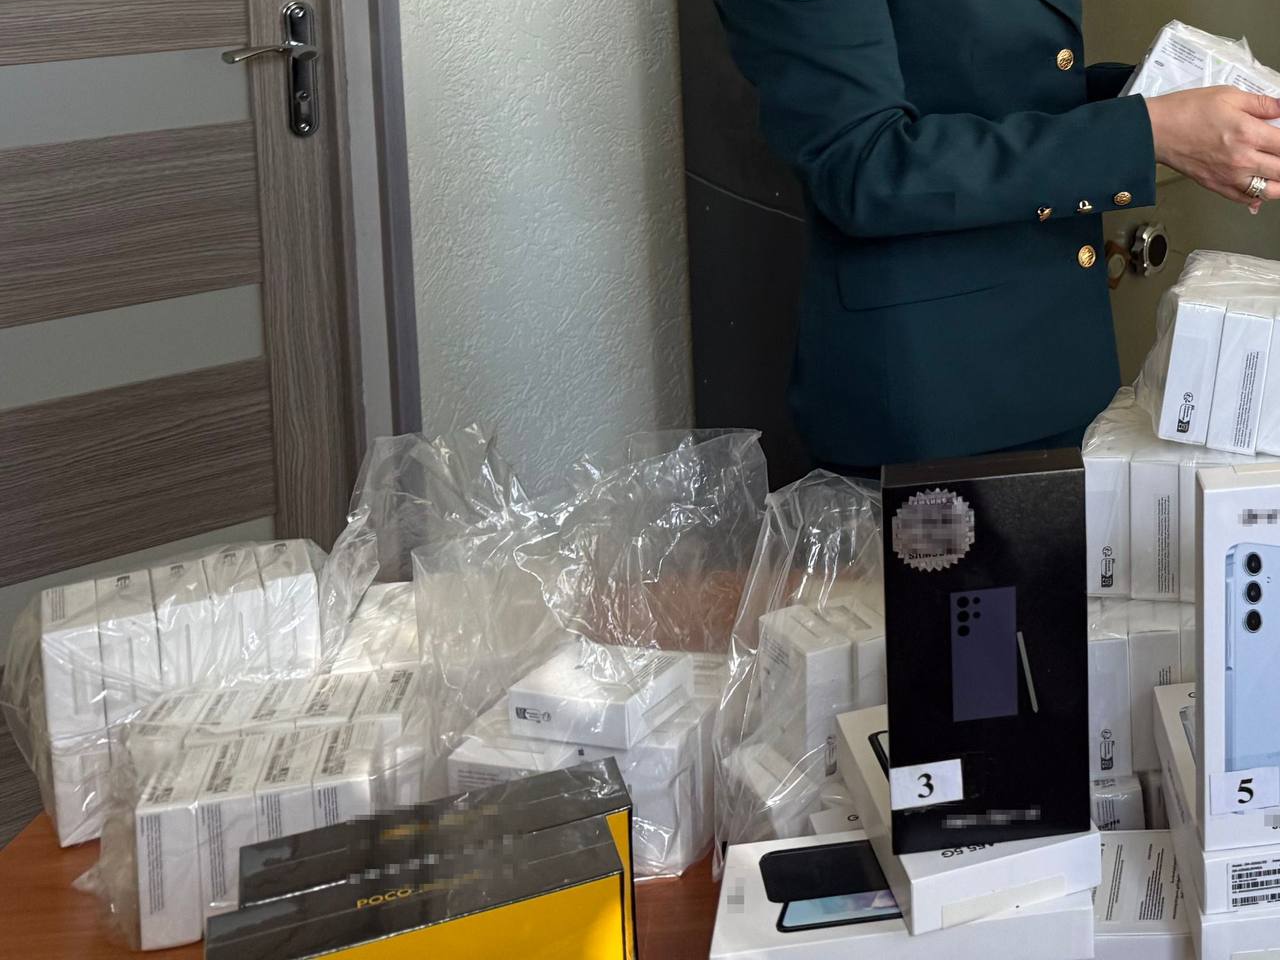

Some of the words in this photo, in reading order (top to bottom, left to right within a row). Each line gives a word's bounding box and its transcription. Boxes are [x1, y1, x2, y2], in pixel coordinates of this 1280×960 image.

[917, 773, 935, 799] 3
[1237, 778, 1255, 804] 5
[941, 847, 963, 858] 5G
[357, 889, 411, 908] POCO
